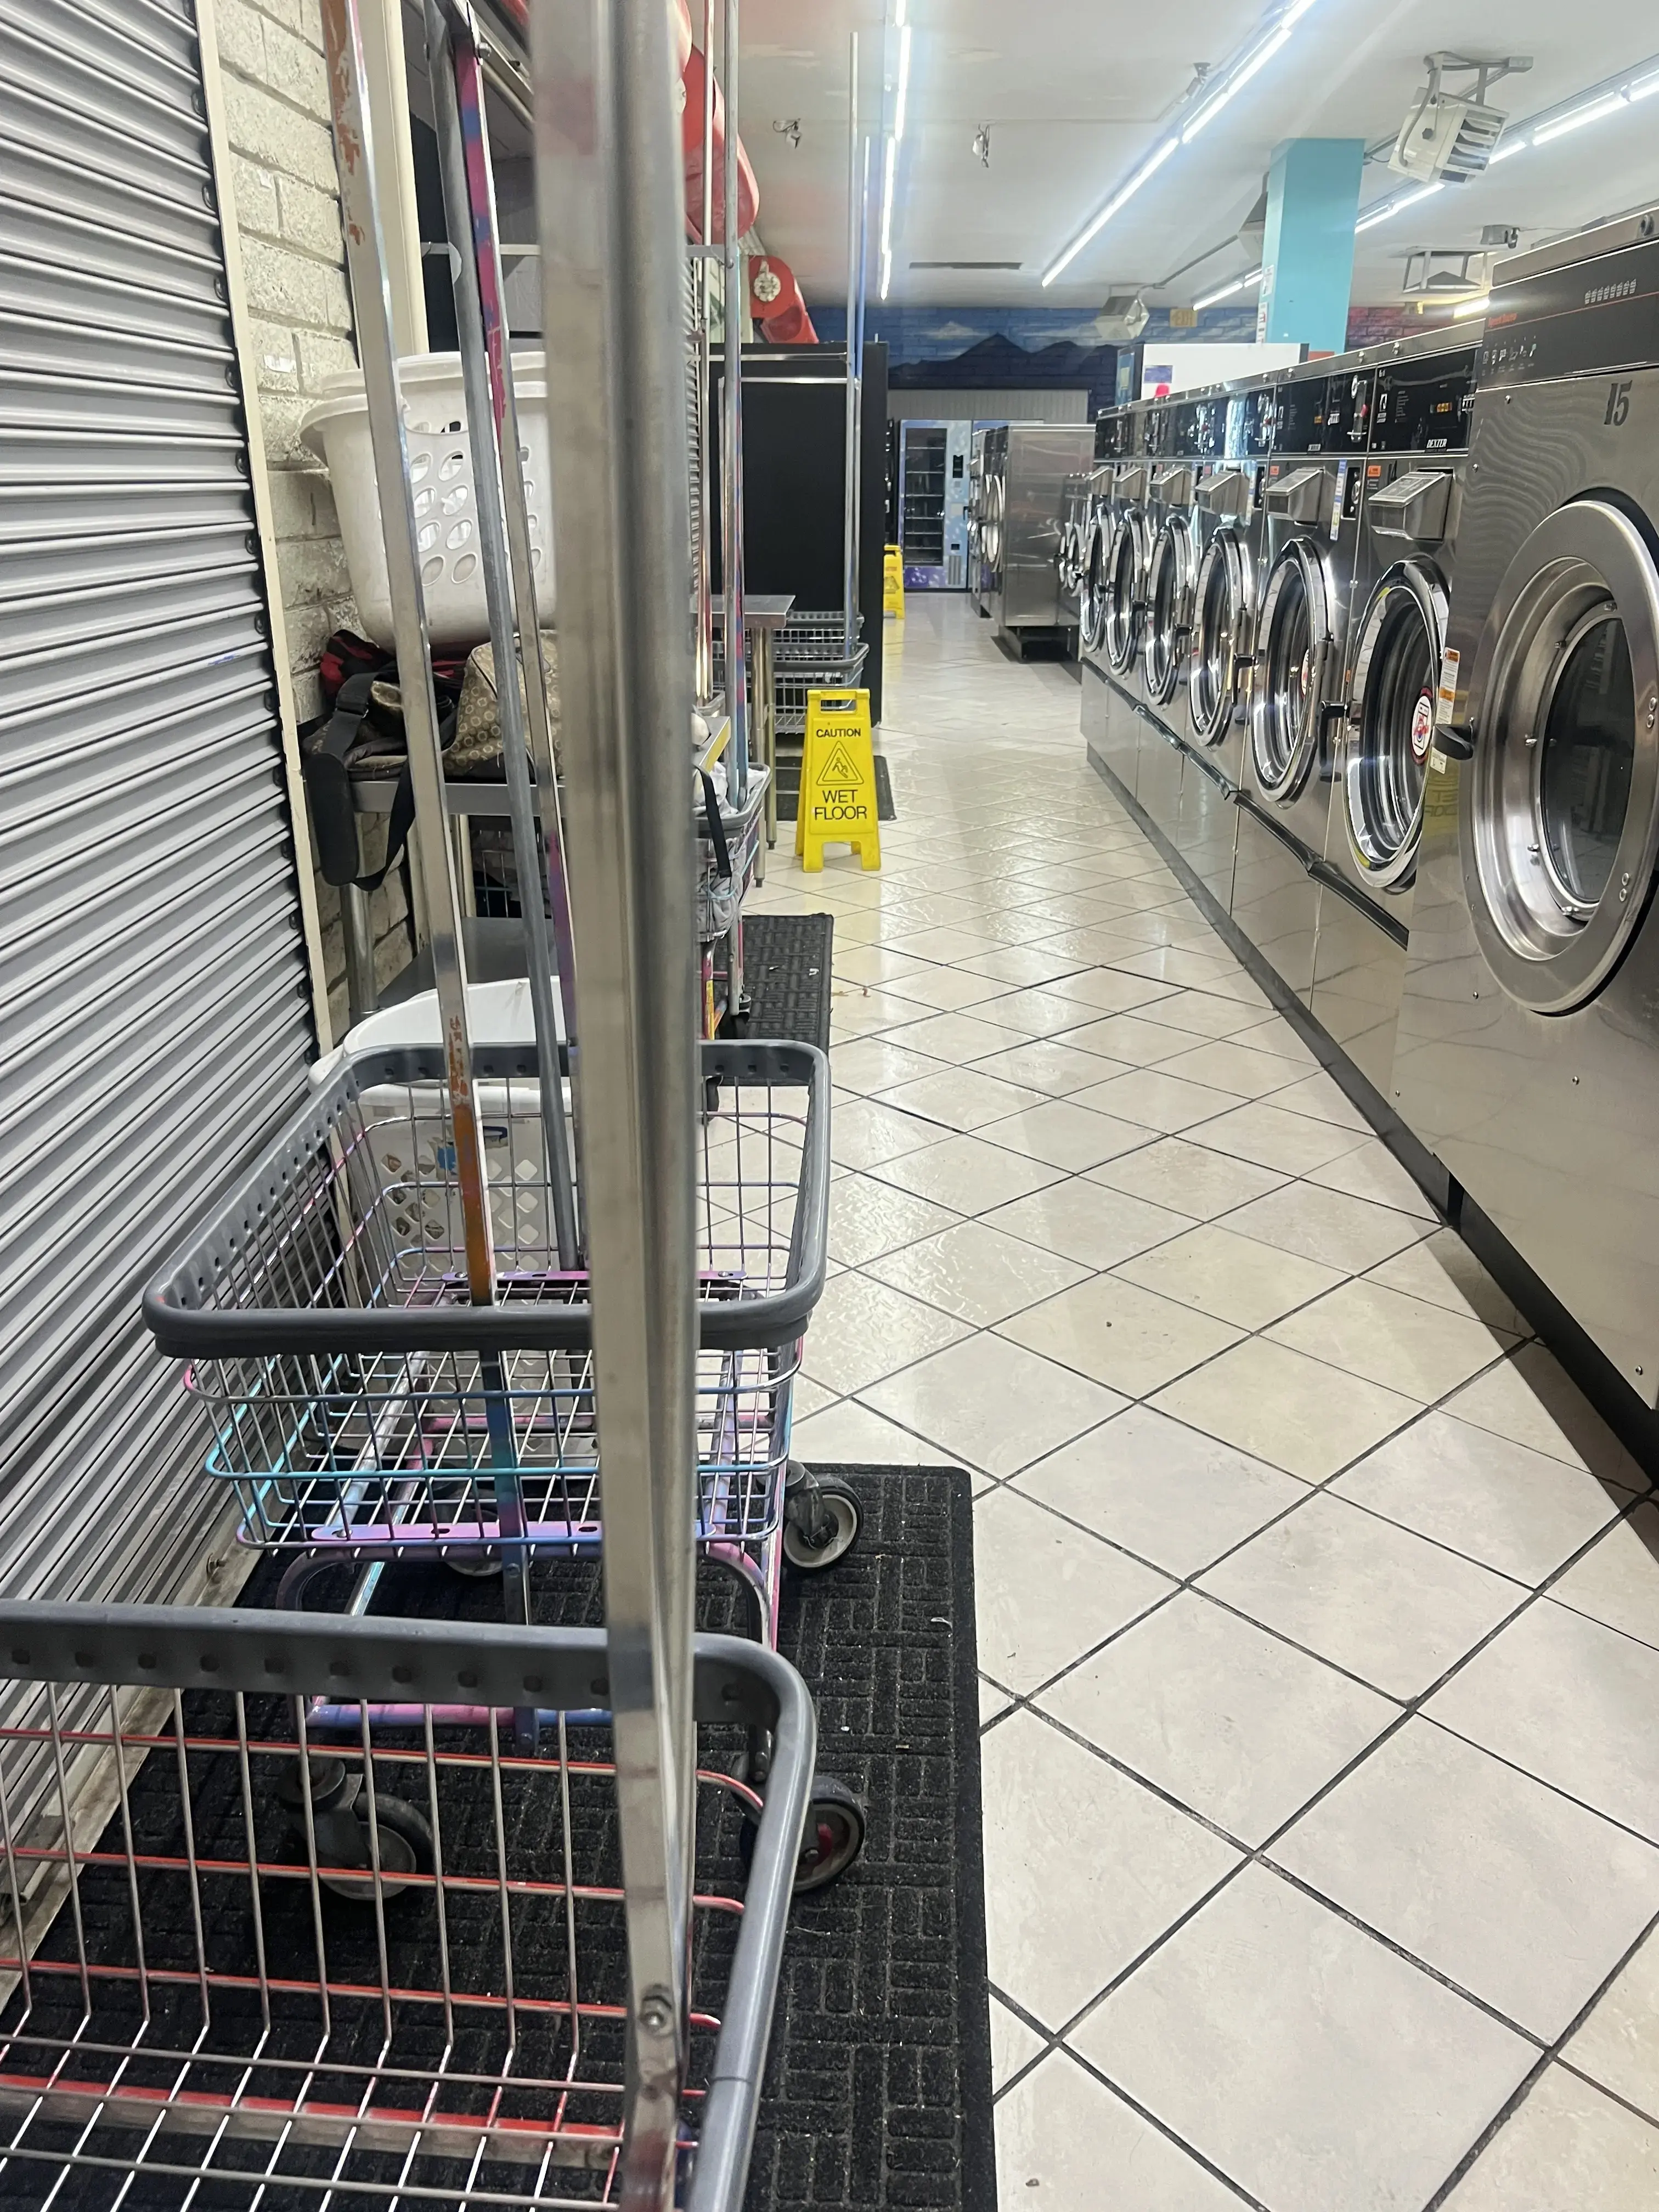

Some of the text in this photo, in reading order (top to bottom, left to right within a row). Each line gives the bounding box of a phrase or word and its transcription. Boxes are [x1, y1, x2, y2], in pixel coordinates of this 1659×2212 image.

[1604, 380, 1633, 426] 15
[1426, 438, 1447, 449] DEXTER
[816, 729, 861, 737] CAUTION
[822, 789, 858, 804] WET
[814, 806, 867, 820] FLOOR
